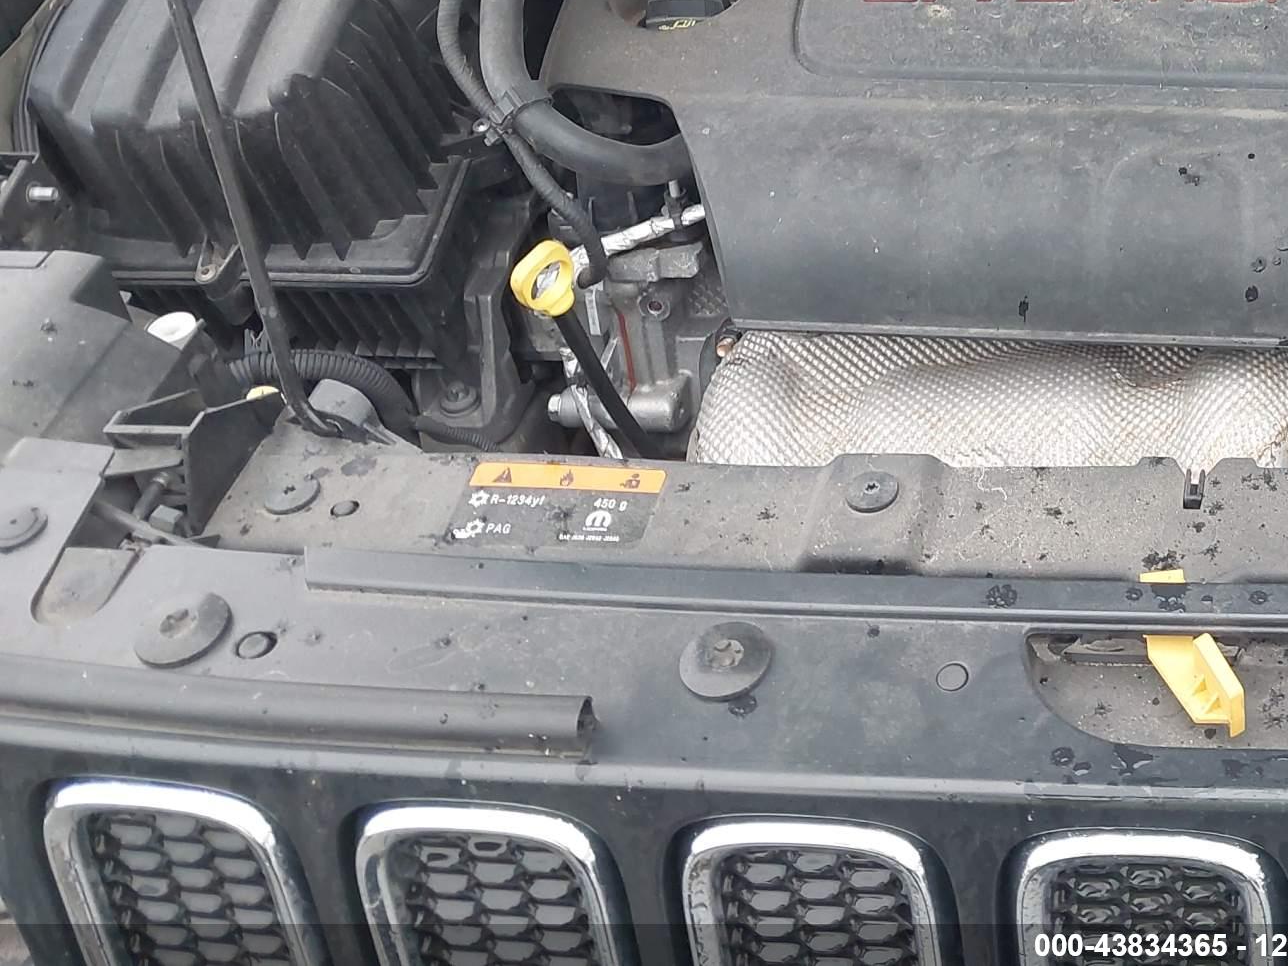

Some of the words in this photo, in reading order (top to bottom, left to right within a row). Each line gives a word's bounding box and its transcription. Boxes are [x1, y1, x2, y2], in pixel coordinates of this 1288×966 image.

[490, 494, 545, 507] R-1234yf
[594, 498, 616, 509] 450
[619, 501, 627, 511] g
[486, 523, 511, 534] PAG
